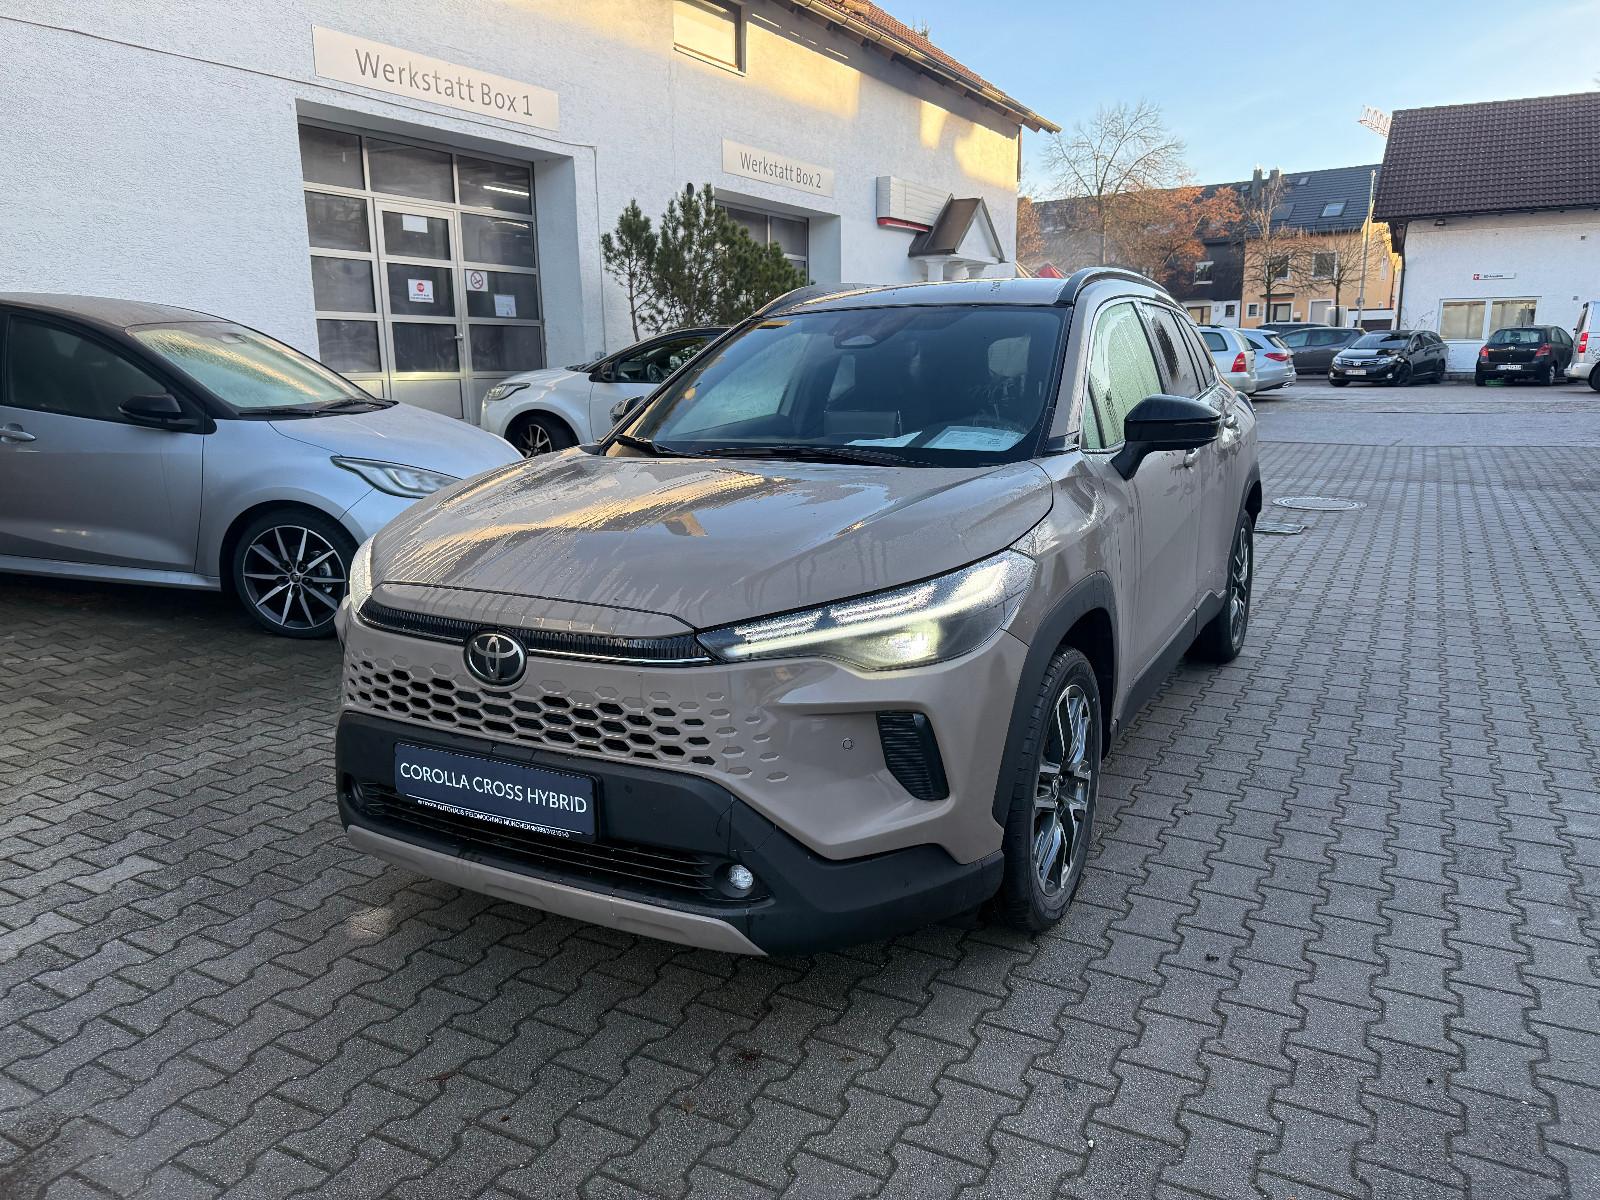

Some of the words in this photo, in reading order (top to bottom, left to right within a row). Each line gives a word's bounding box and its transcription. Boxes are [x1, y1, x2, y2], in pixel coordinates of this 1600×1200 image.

[354, 48, 476, 103] Werkstatt
[480, 82, 518, 113] Box
[522, 94, 533, 117] 1
[739, 151, 795, 182] Werkstatt
[796, 167, 814, 188] Box
[815, 173, 822, 189] 2
[400, 762, 470, 790] COROLLA
[472, 776, 524, 802] CROSS
[527, 787, 588, 814] HYBRID
[437, 804, 465, 816] AUTOHAUS
